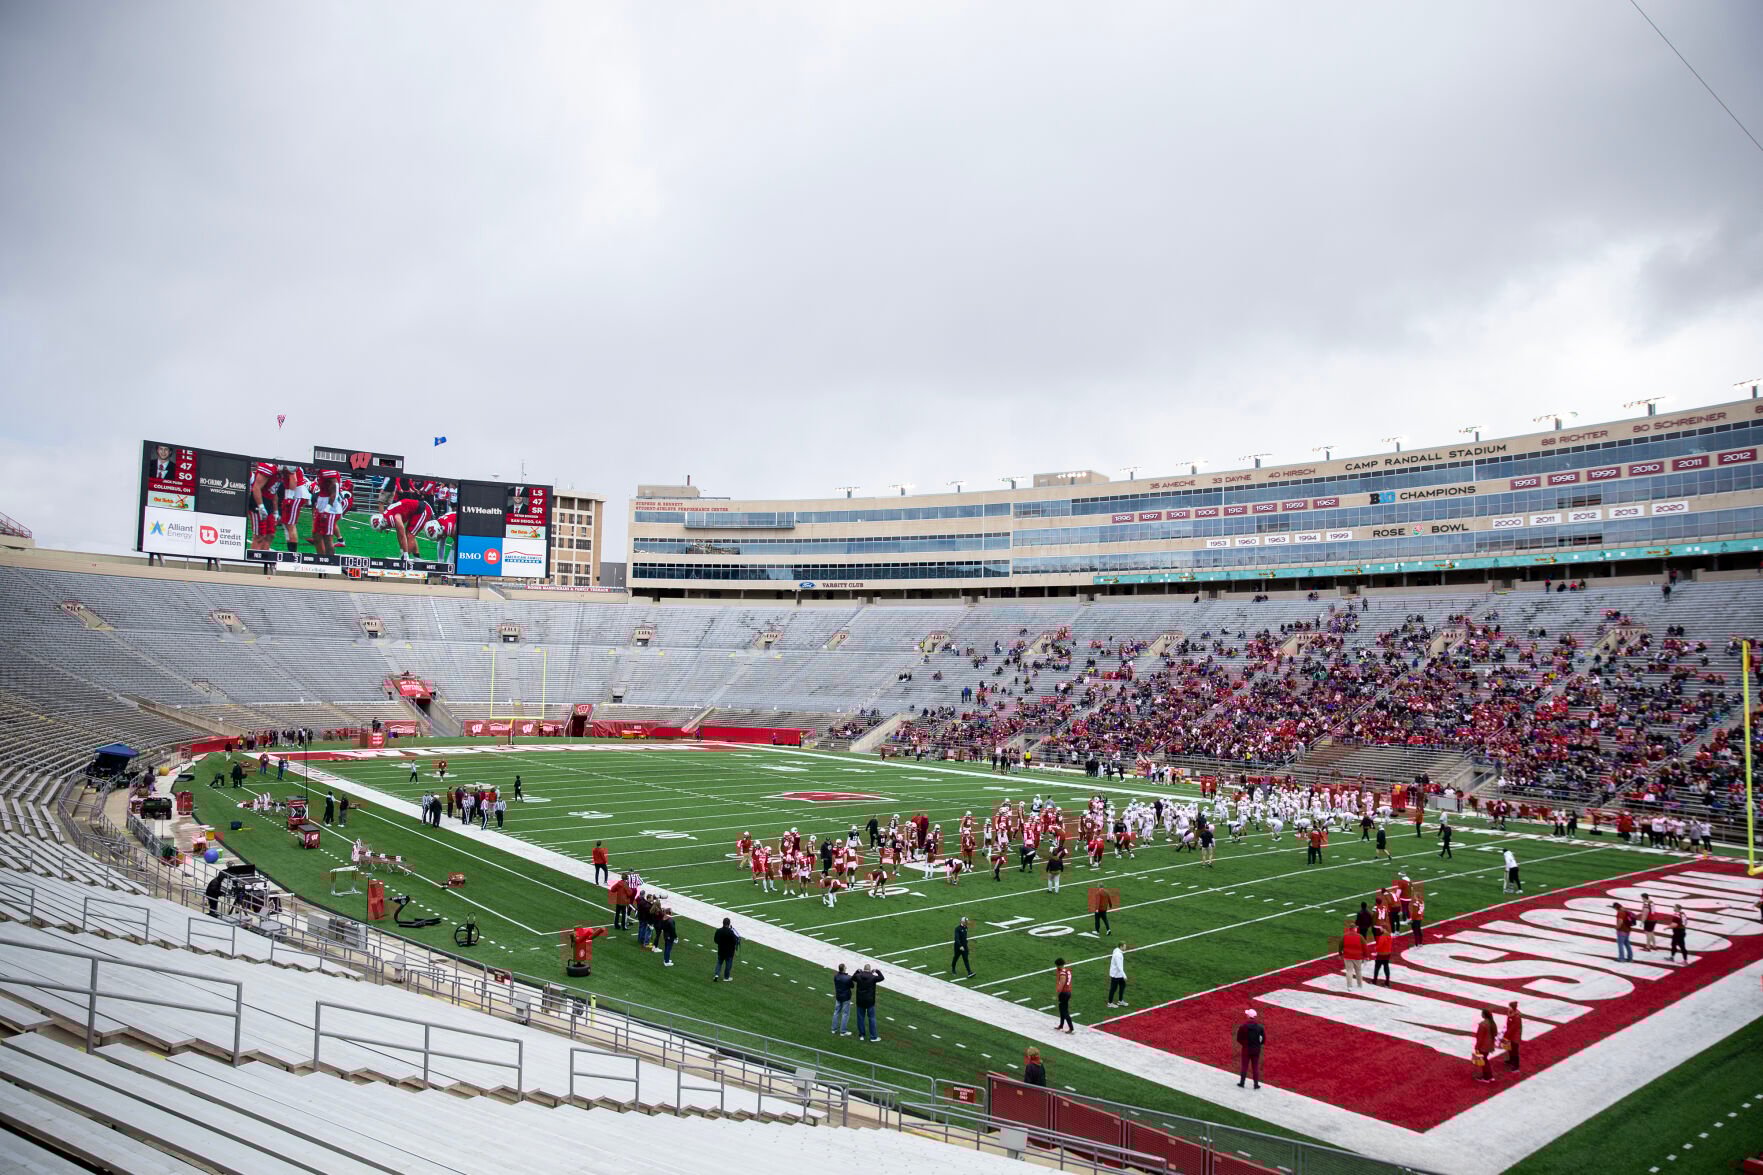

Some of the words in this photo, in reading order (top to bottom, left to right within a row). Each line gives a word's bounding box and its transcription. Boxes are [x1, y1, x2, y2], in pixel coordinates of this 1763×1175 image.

[1632, 423, 1650, 432] 80
[1654, 412, 1727, 430] SCHREINER
[1541, 438, 1556, 446] 88
[1559, 430, 1608, 444] RICHTER
[1345, 460, 1378, 471] CAMP
[1384, 453, 1442, 466] RANDALL
[1448, 444, 1507, 458] STADIUM
[1722, 451, 1751, 462] 2012
[180, 462, 192, 470] 47
[1678, 458, 1702, 468] 2011
[1282, 468, 1316, 477] HIRSCH
[1590, 469, 1616, 478] 1999
[1632, 464, 1660, 474] 2010
[1225, 474, 1252, 483] DAYNE
[1514, 478, 1537, 487] 1993
[154, 484, 182, 492] COLUMBUS,
[1161, 480, 1196, 488] AMECHE
[1400, 486, 1476, 500] CHAMPIONS
[1614, 507, 1638, 516] 2013
[1655, 503, 1684, 512] 2020
[1535, 515, 1555, 524] 2011
[1573, 512, 1596, 520] 2012
[168, 523, 193, 532] Alliant
[1494, 519, 1522, 527] 2000
[168, 530, 192, 539] Energy
[1372, 528, 1406, 537] ROSE
[1431, 524, 1469, 534] BOWL
[345, 557, 369, 567] 10:00
[349, 568, 360, 577] 40
